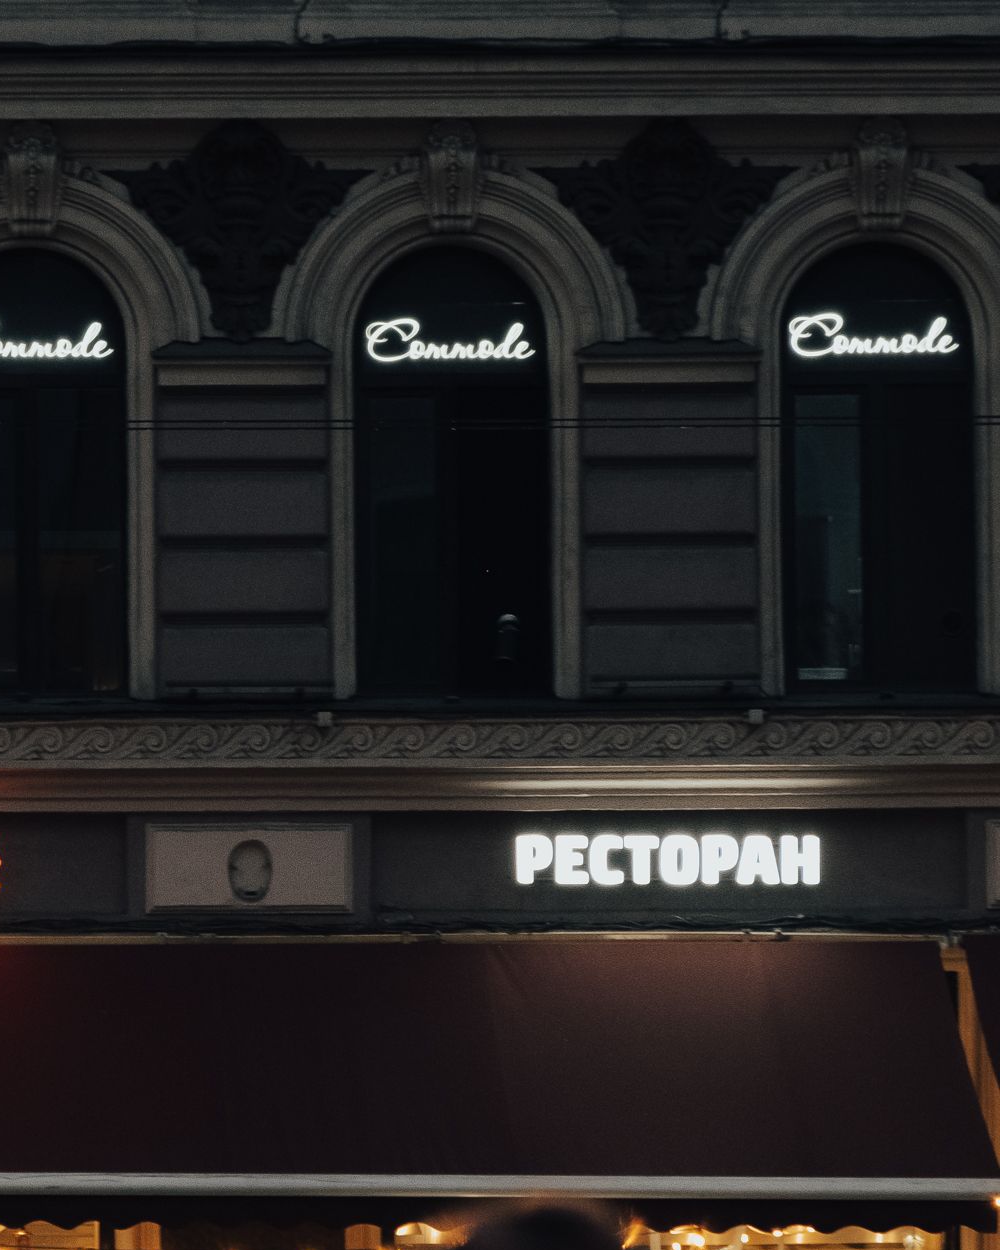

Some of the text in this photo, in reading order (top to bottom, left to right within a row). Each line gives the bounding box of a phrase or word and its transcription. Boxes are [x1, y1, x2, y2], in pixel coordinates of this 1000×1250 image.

[365, 317, 535, 362] Commode
[788, 311, 959, 358] Commode
[514, 834, 821, 887] РЕСТОРАН
